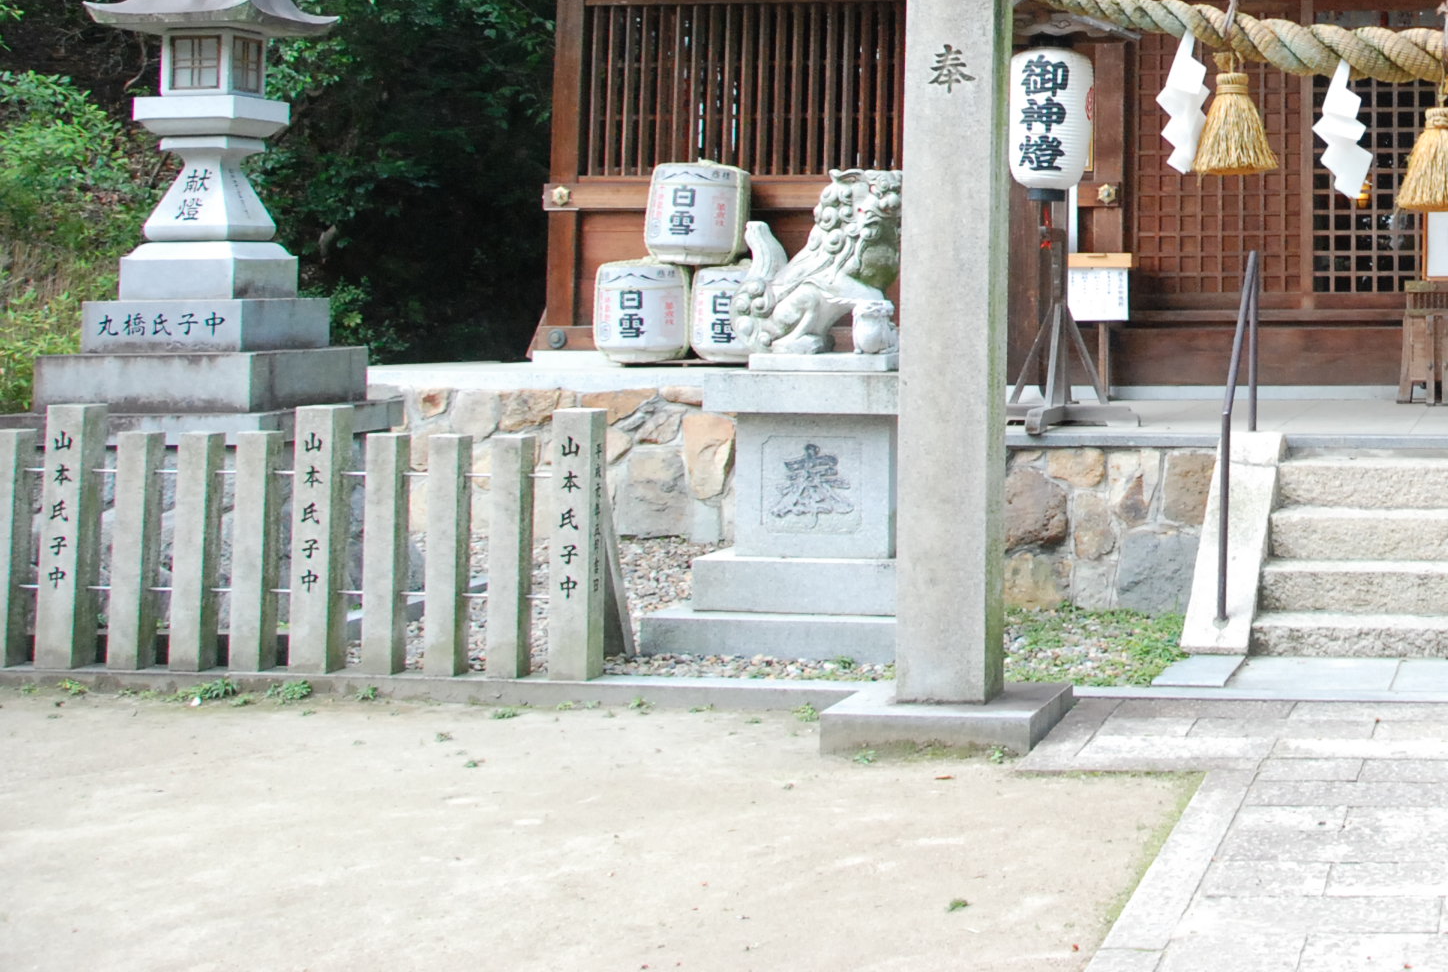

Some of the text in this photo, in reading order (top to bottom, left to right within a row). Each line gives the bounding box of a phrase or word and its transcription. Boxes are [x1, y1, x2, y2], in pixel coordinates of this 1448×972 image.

[928, 44, 976, 94] 奉
[1019, 54, 1069, 172] 御神燈
[669, 185, 696, 235] 白雪
[98, 311, 226, 337] 丸橋氏子中
[619, 286, 647, 338] 白雪
[48, 430, 73, 589] 山本氏子中
[300, 431, 323, 593] 山本氏子中
[558, 436, 582, 600] 山本氏子中
